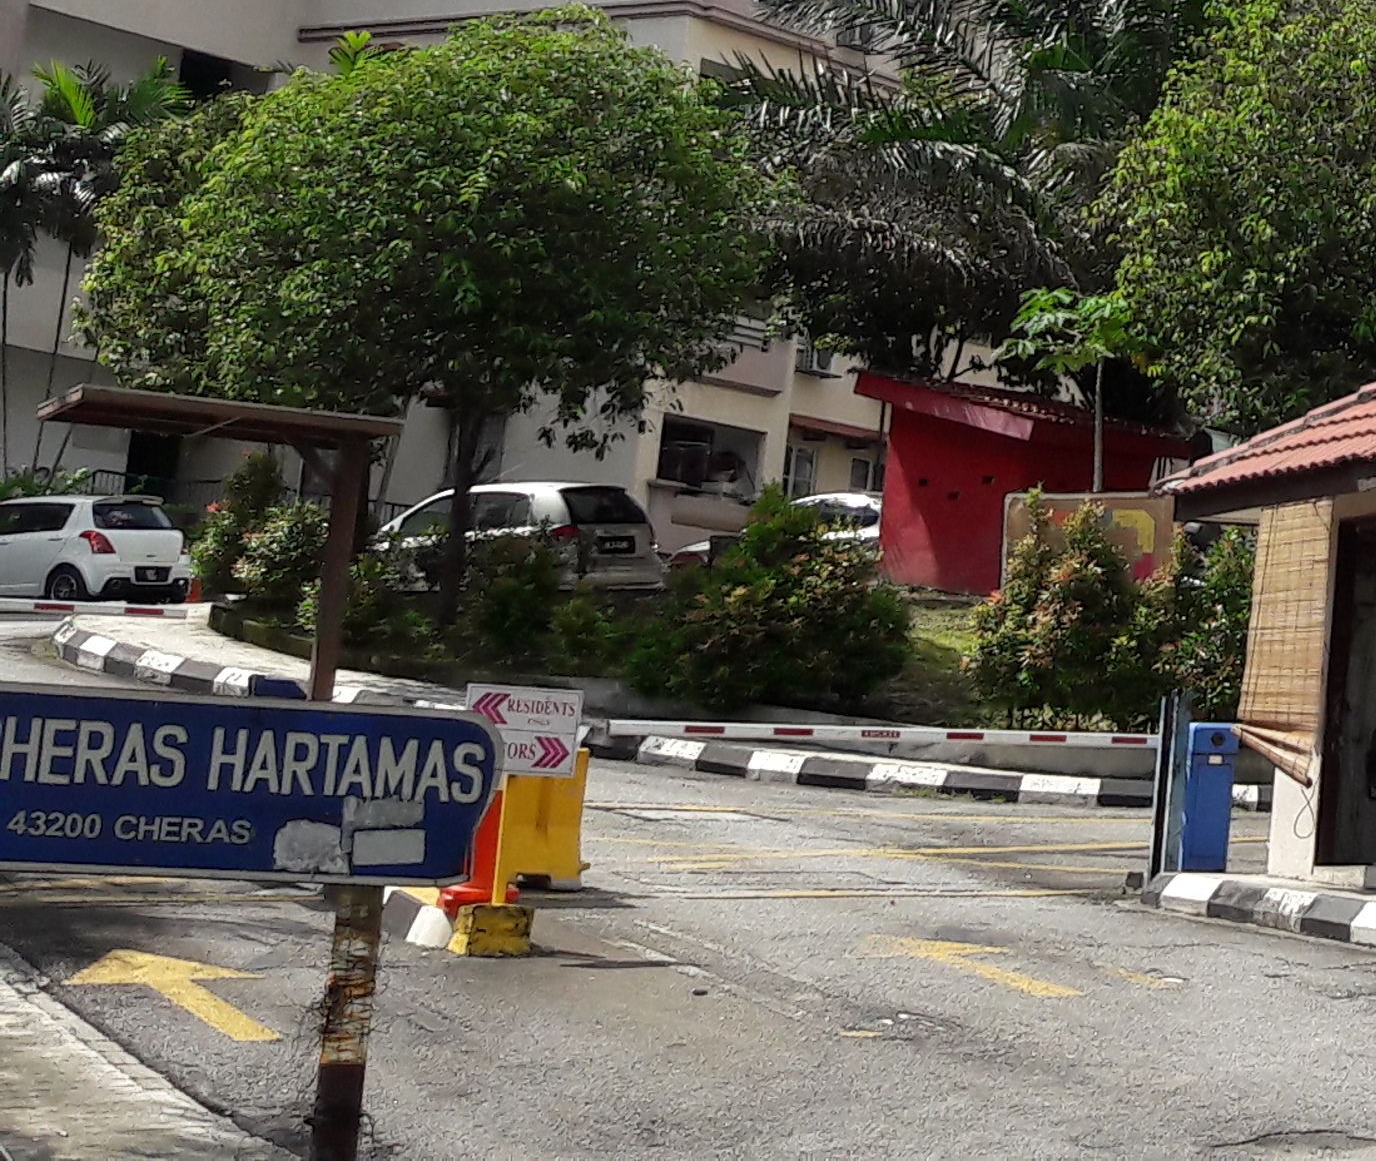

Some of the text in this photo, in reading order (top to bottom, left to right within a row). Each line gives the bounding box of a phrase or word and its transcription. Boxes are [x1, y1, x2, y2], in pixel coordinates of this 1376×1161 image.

[507, 698, 576, 717] RESIDENTS
[0, 715, 486, 804] HERAS HARTAMAS
[7, 809, 253, 845] 43200 CHERAS
